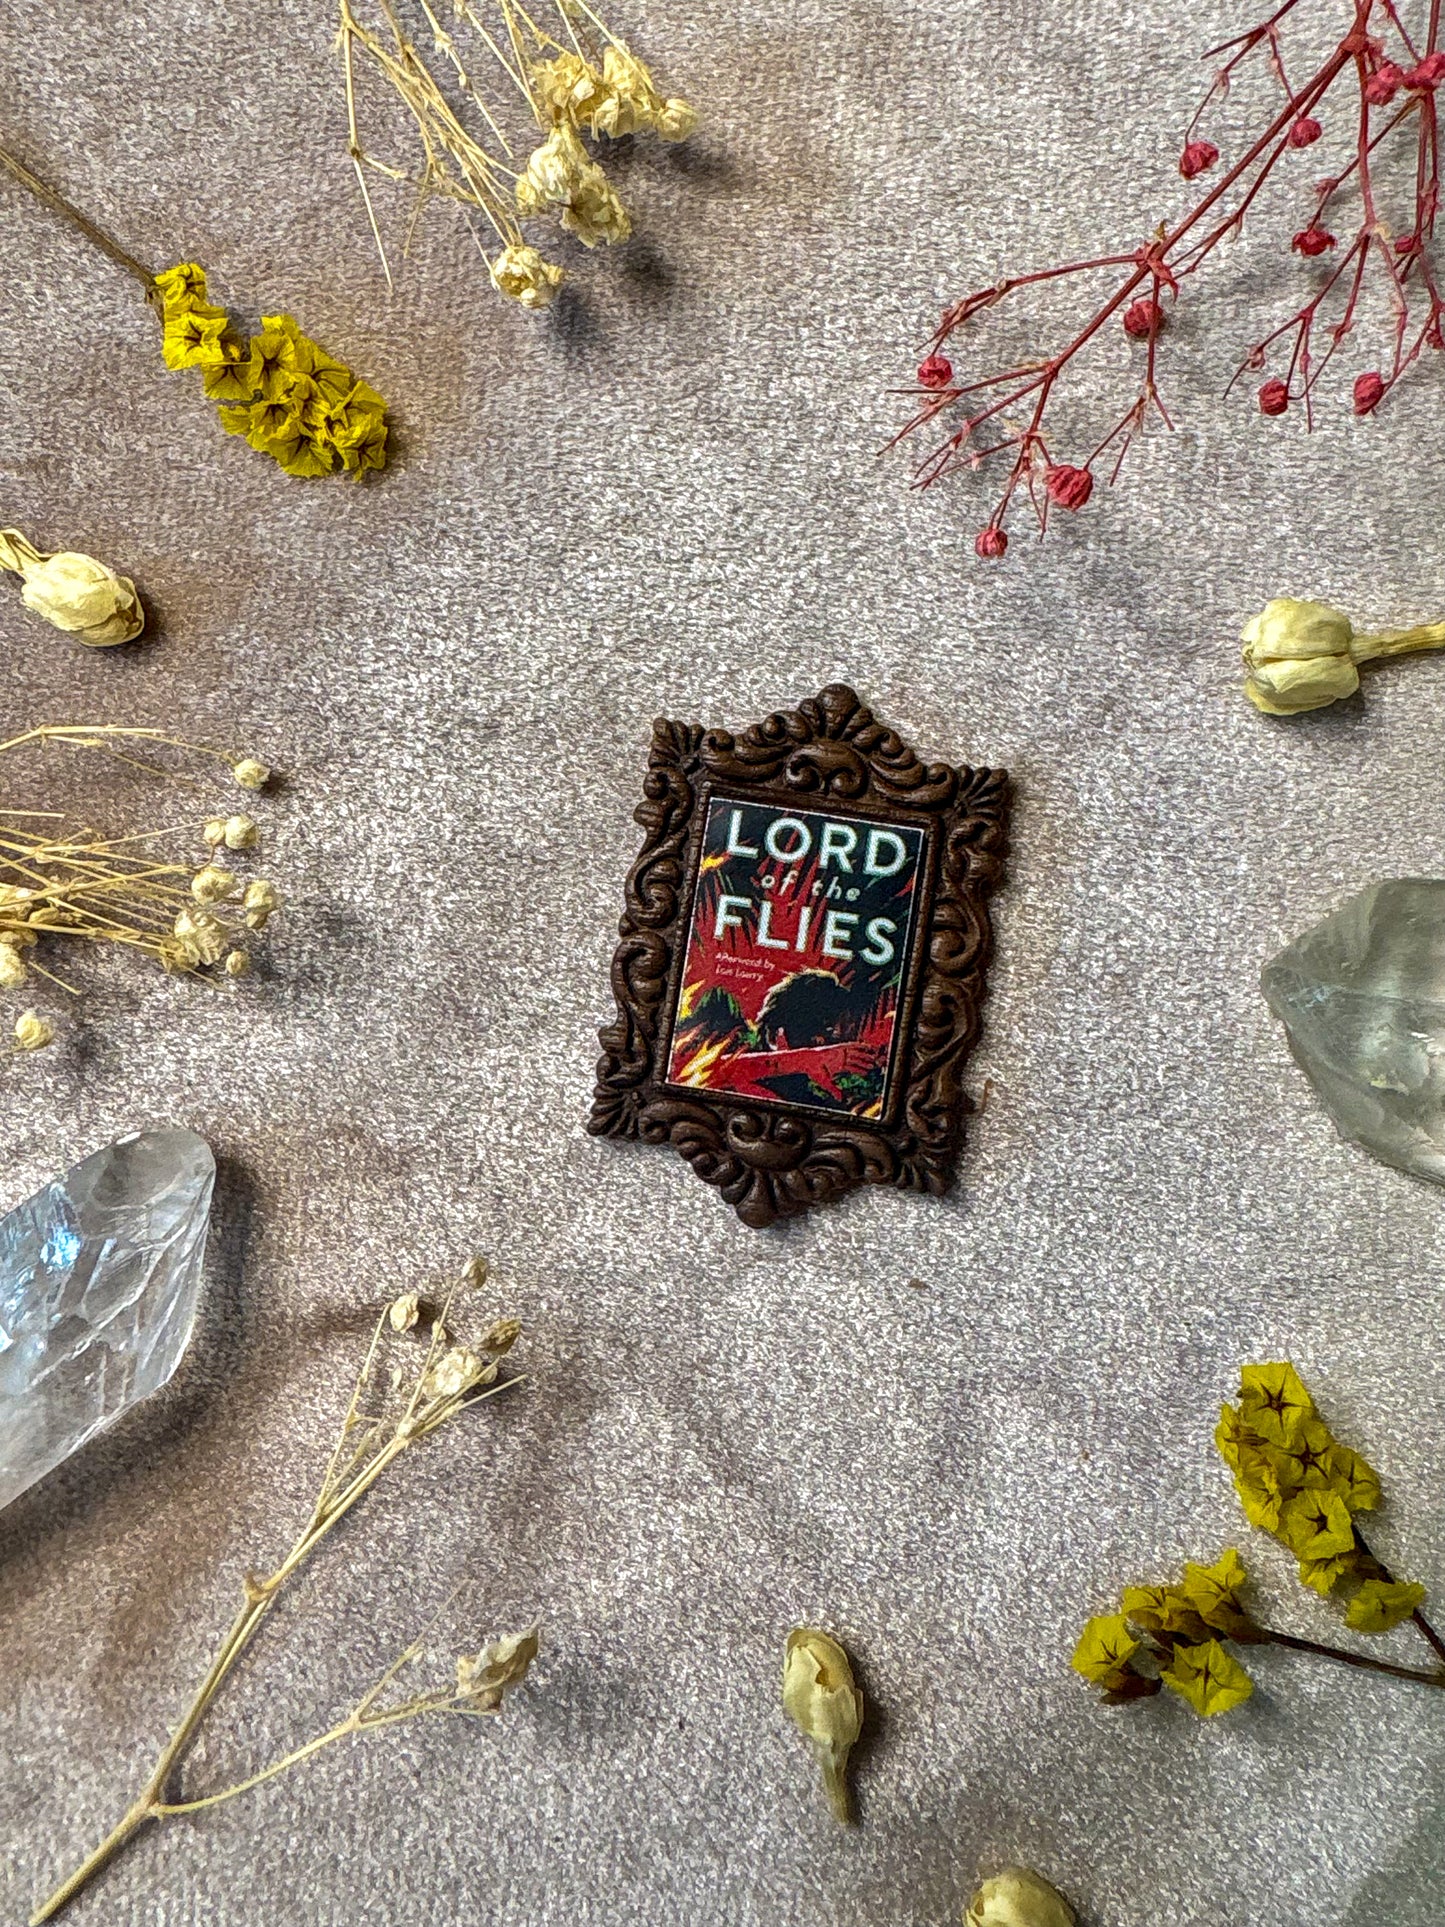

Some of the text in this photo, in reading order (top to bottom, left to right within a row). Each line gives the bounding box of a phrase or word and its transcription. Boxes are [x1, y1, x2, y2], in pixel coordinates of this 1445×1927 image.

[727, 809, 906, 877] LORD
[761, 870, 861, 901] of the
[713, 894, 898, 966] FLIES
